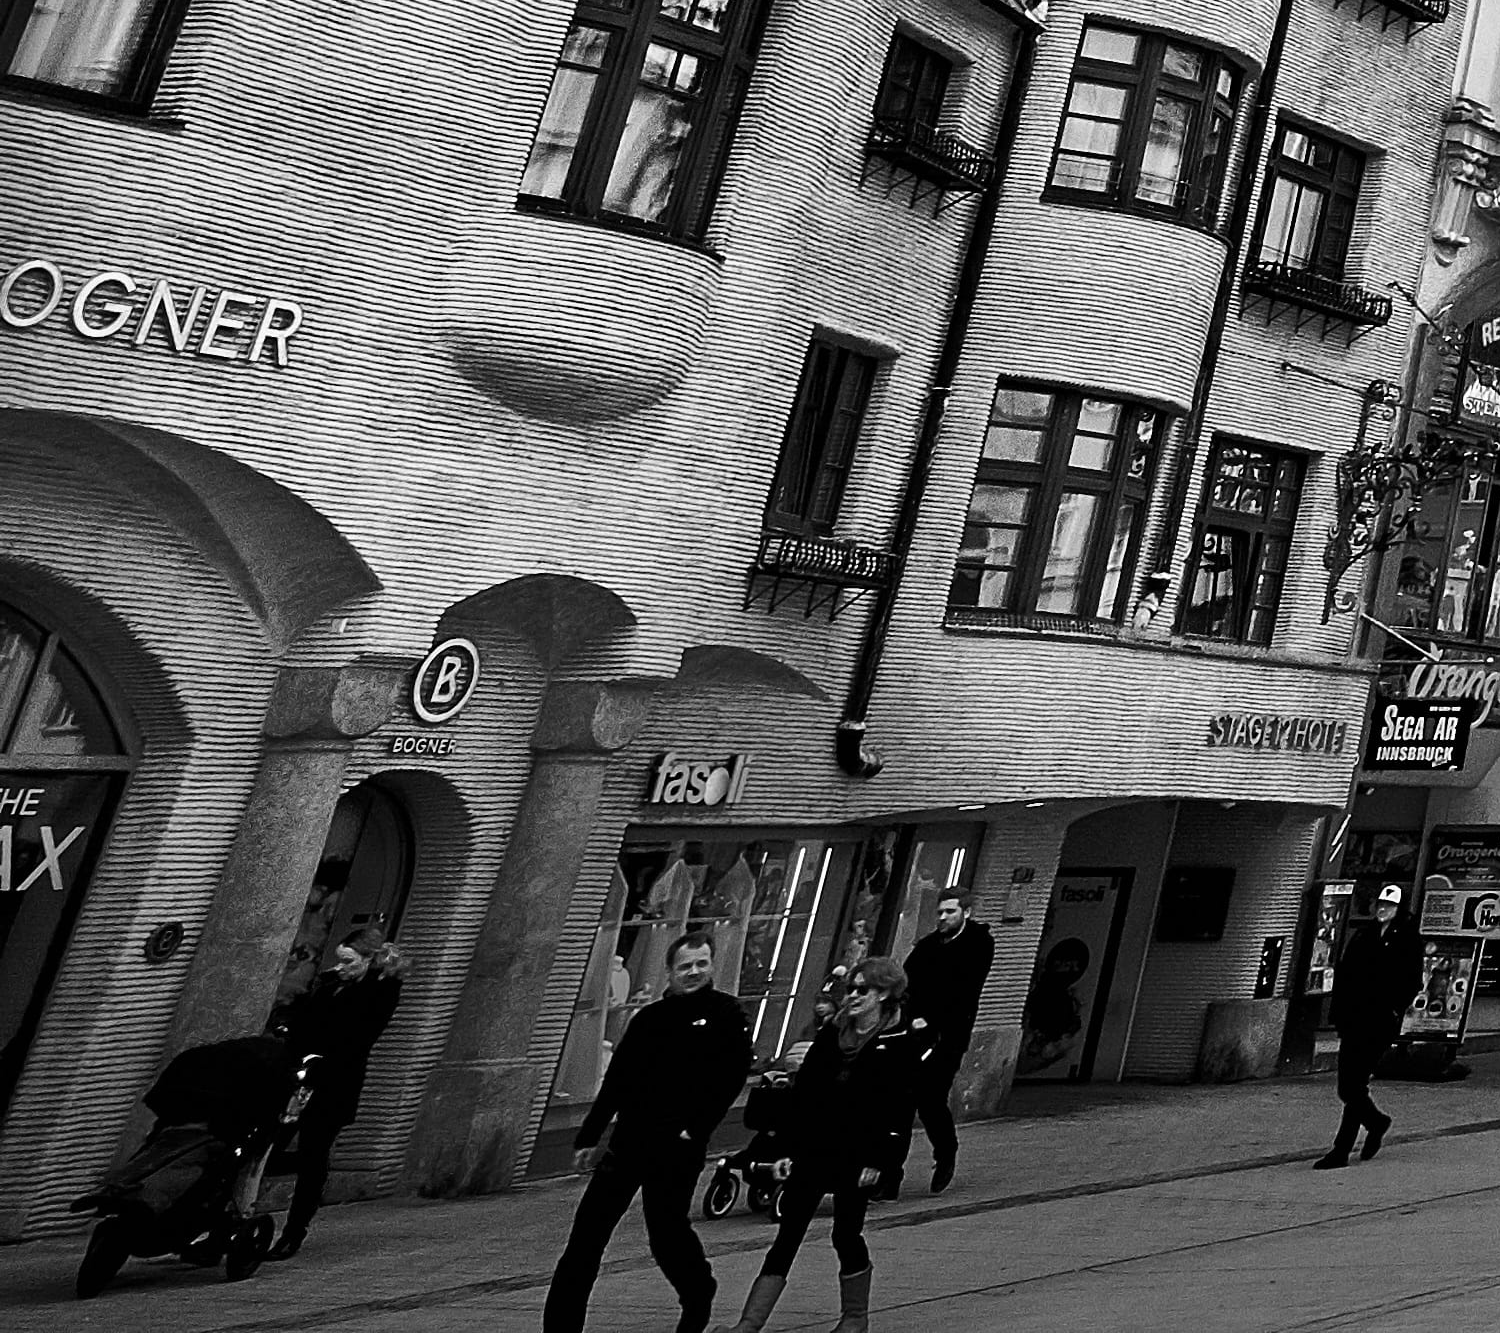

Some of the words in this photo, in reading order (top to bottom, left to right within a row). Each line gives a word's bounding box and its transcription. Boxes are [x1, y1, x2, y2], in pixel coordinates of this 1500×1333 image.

[1381, 704, 1458, 741] SEGAAR
[392, 737, 457, 754] BOGNER
[1375, 746, 1454, 762] INNSBRUCK
